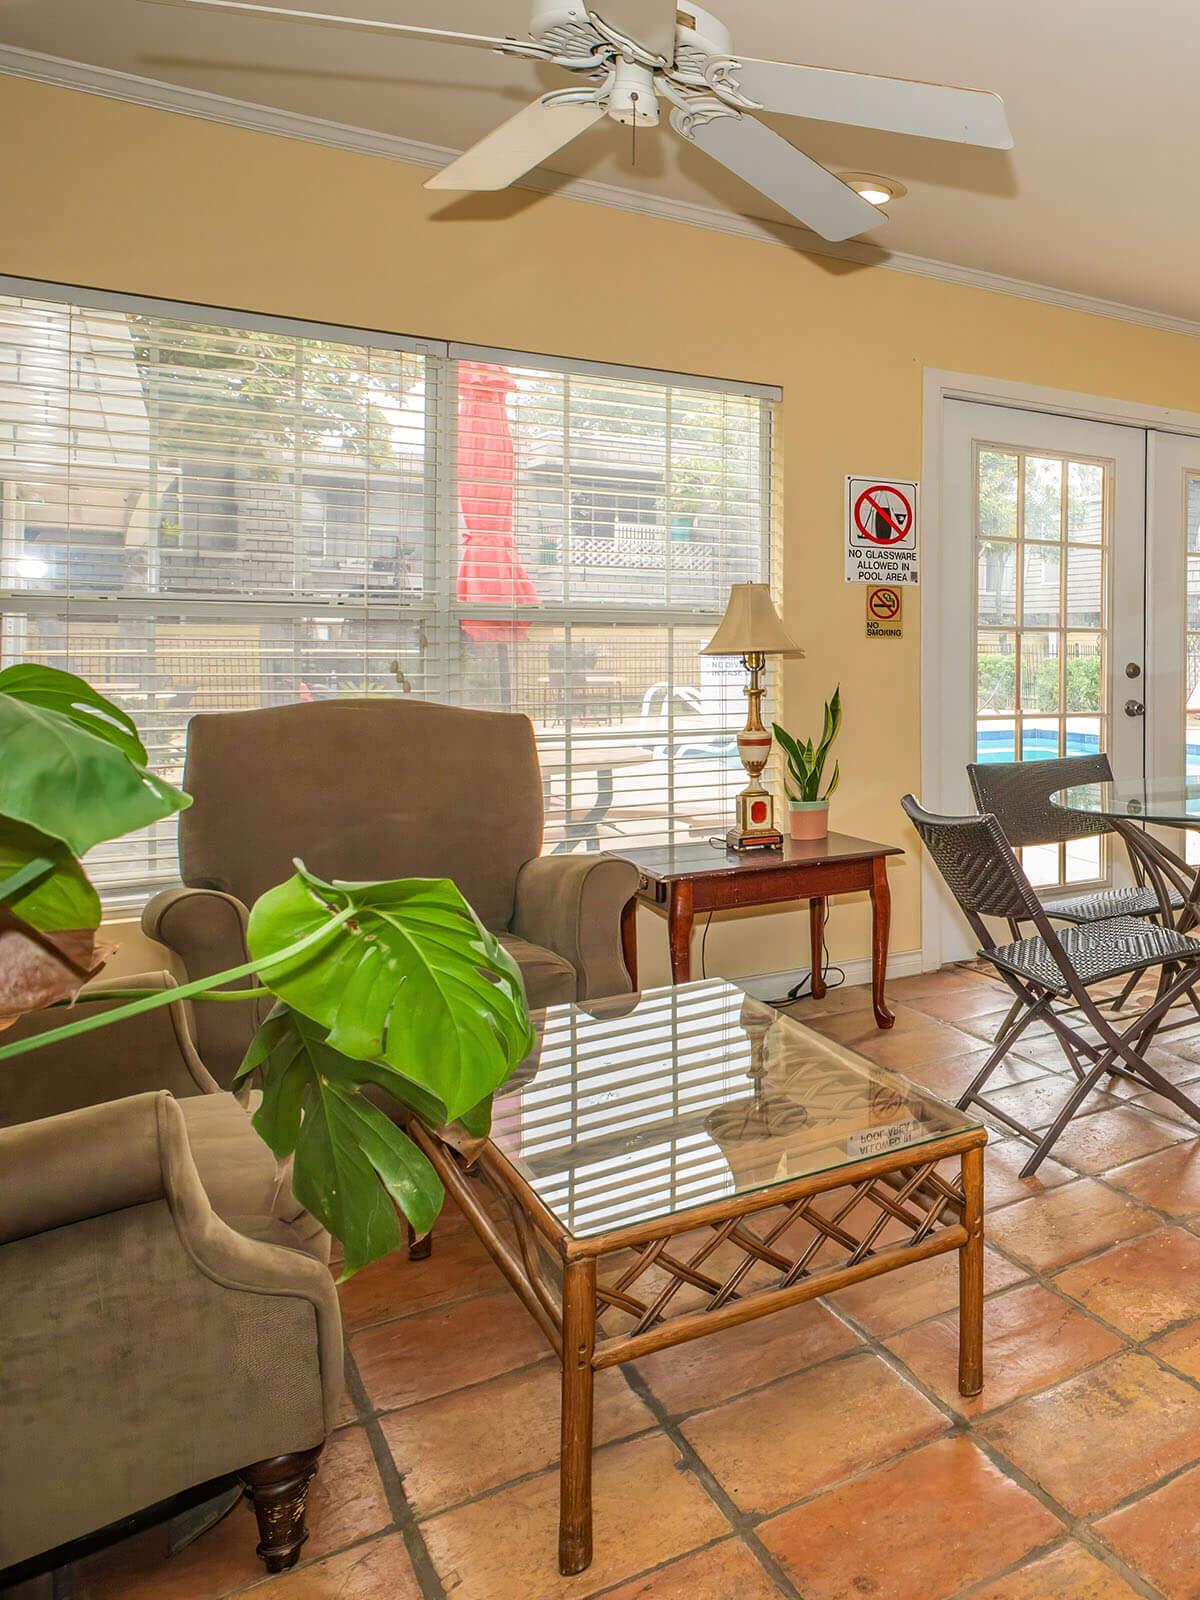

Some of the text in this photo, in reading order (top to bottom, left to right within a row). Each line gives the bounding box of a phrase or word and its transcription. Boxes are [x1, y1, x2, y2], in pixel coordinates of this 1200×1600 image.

[848, 549, 917, 561] NO GLASSWARE
[857, 561, 910, 571] ALLOWED IN
[858, 571, 883, 581] POOL
[885, 572, 908, 582] AREA
[866, 629, 902, 637] SMOKING
